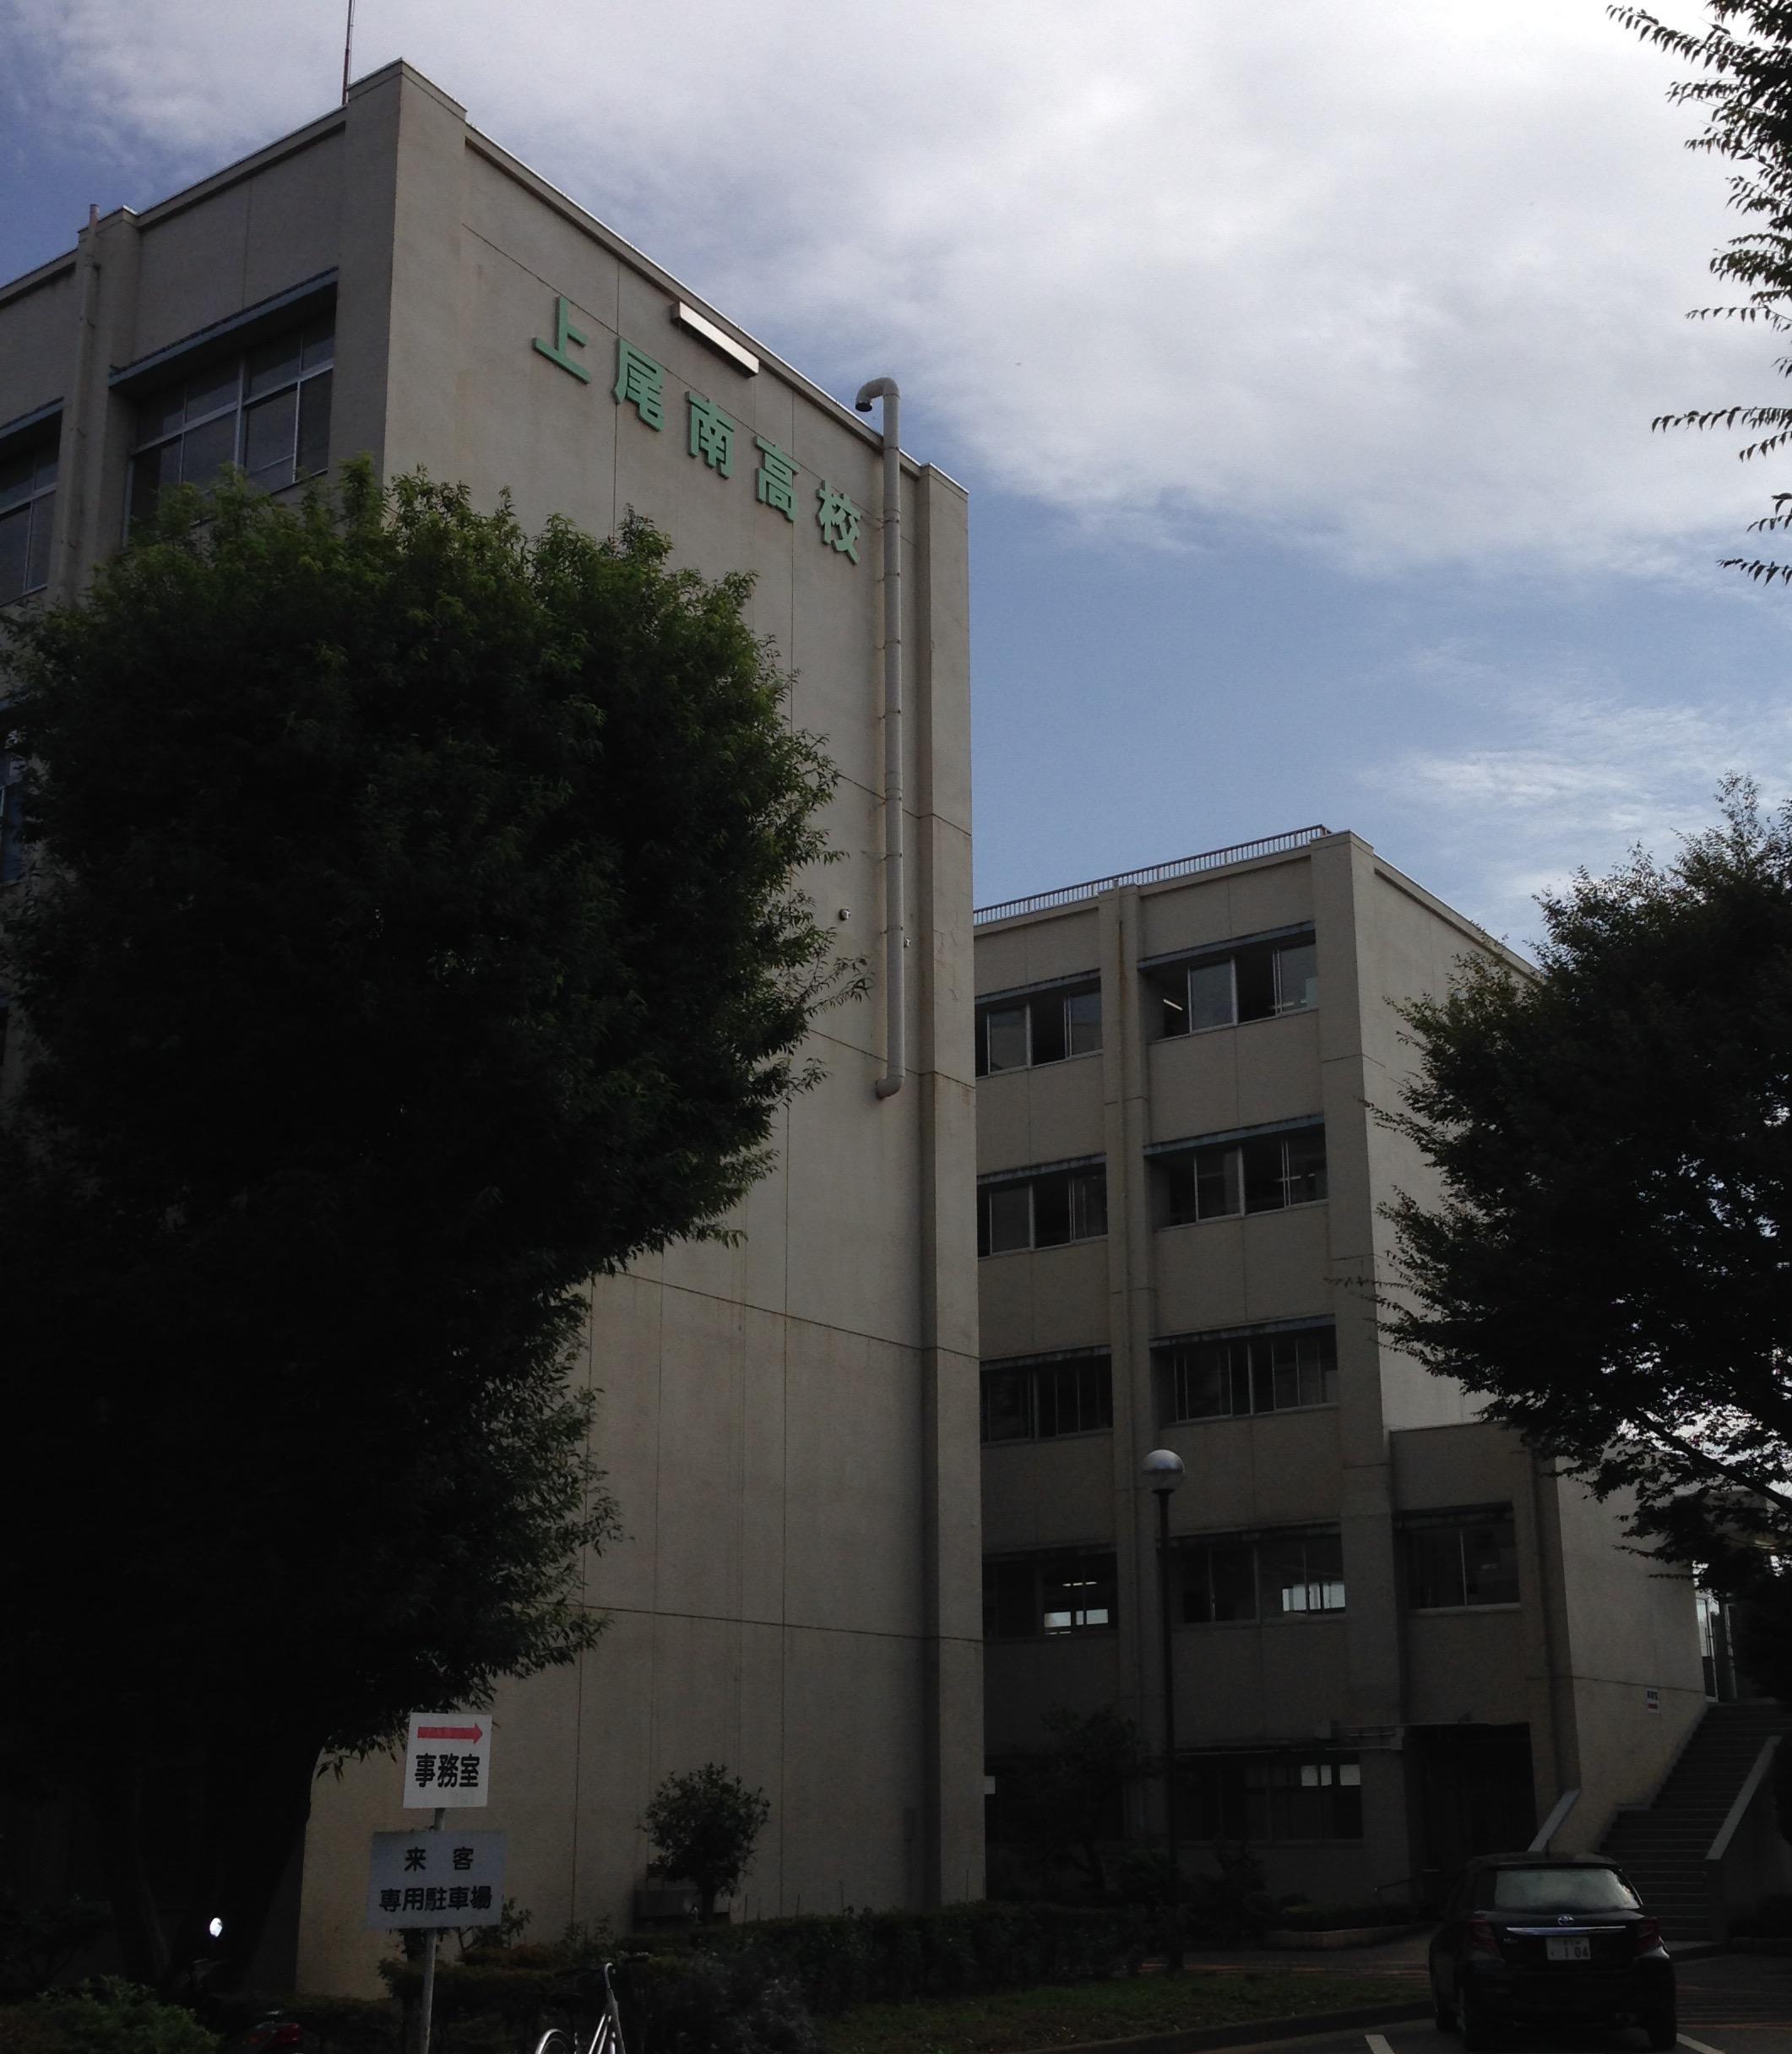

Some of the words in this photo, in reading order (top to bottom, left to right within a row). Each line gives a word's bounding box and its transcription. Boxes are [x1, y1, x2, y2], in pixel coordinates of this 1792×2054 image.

[532, 295, 861, 565] 上尾南高校
[415, 1752, 480, 1788] 事務室
[379, 1885, 492, 1912] 専用駐車場
